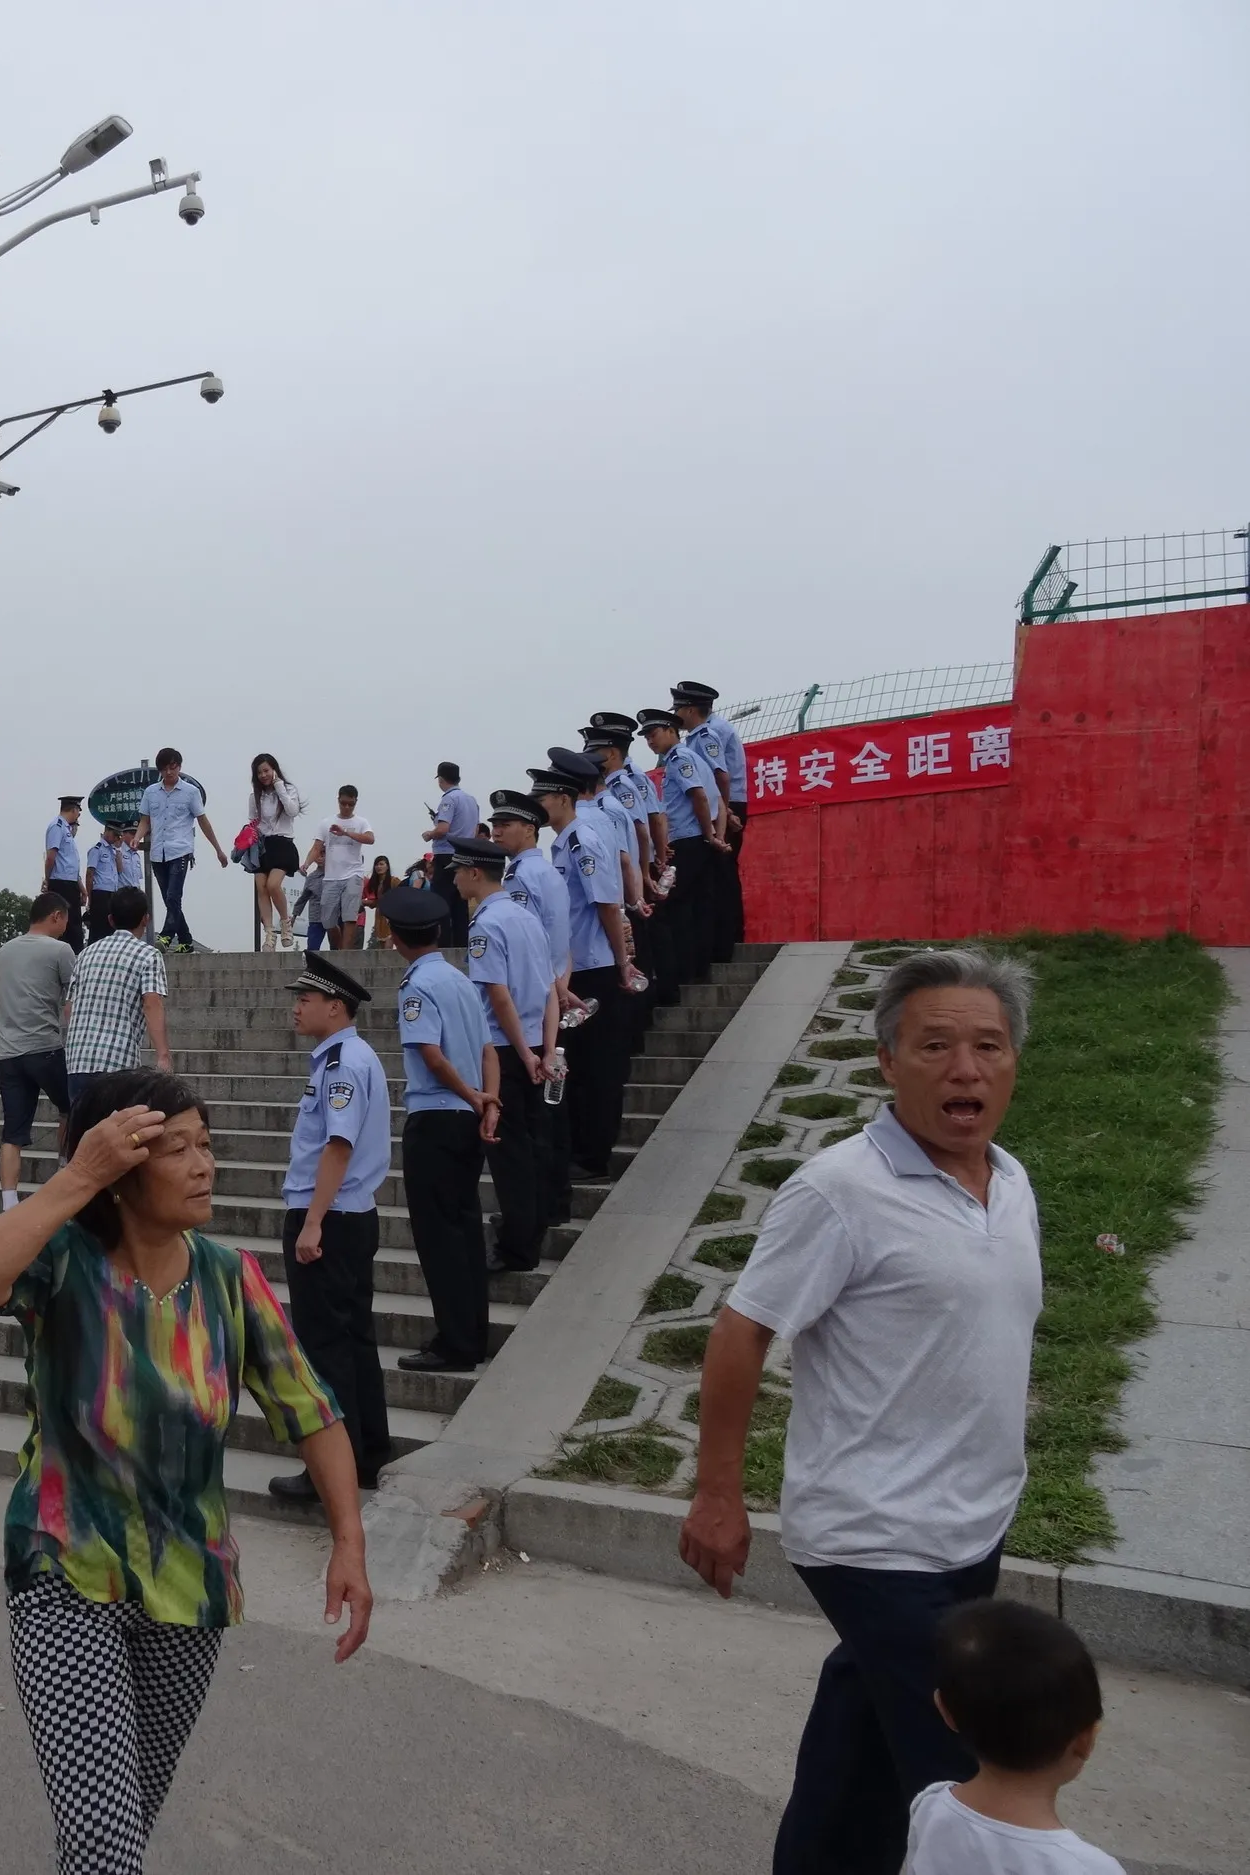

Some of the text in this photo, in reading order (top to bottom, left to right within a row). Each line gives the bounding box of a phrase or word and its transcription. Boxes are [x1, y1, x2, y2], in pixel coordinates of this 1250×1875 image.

[753, 725, 1012, 799] 持安全距离
